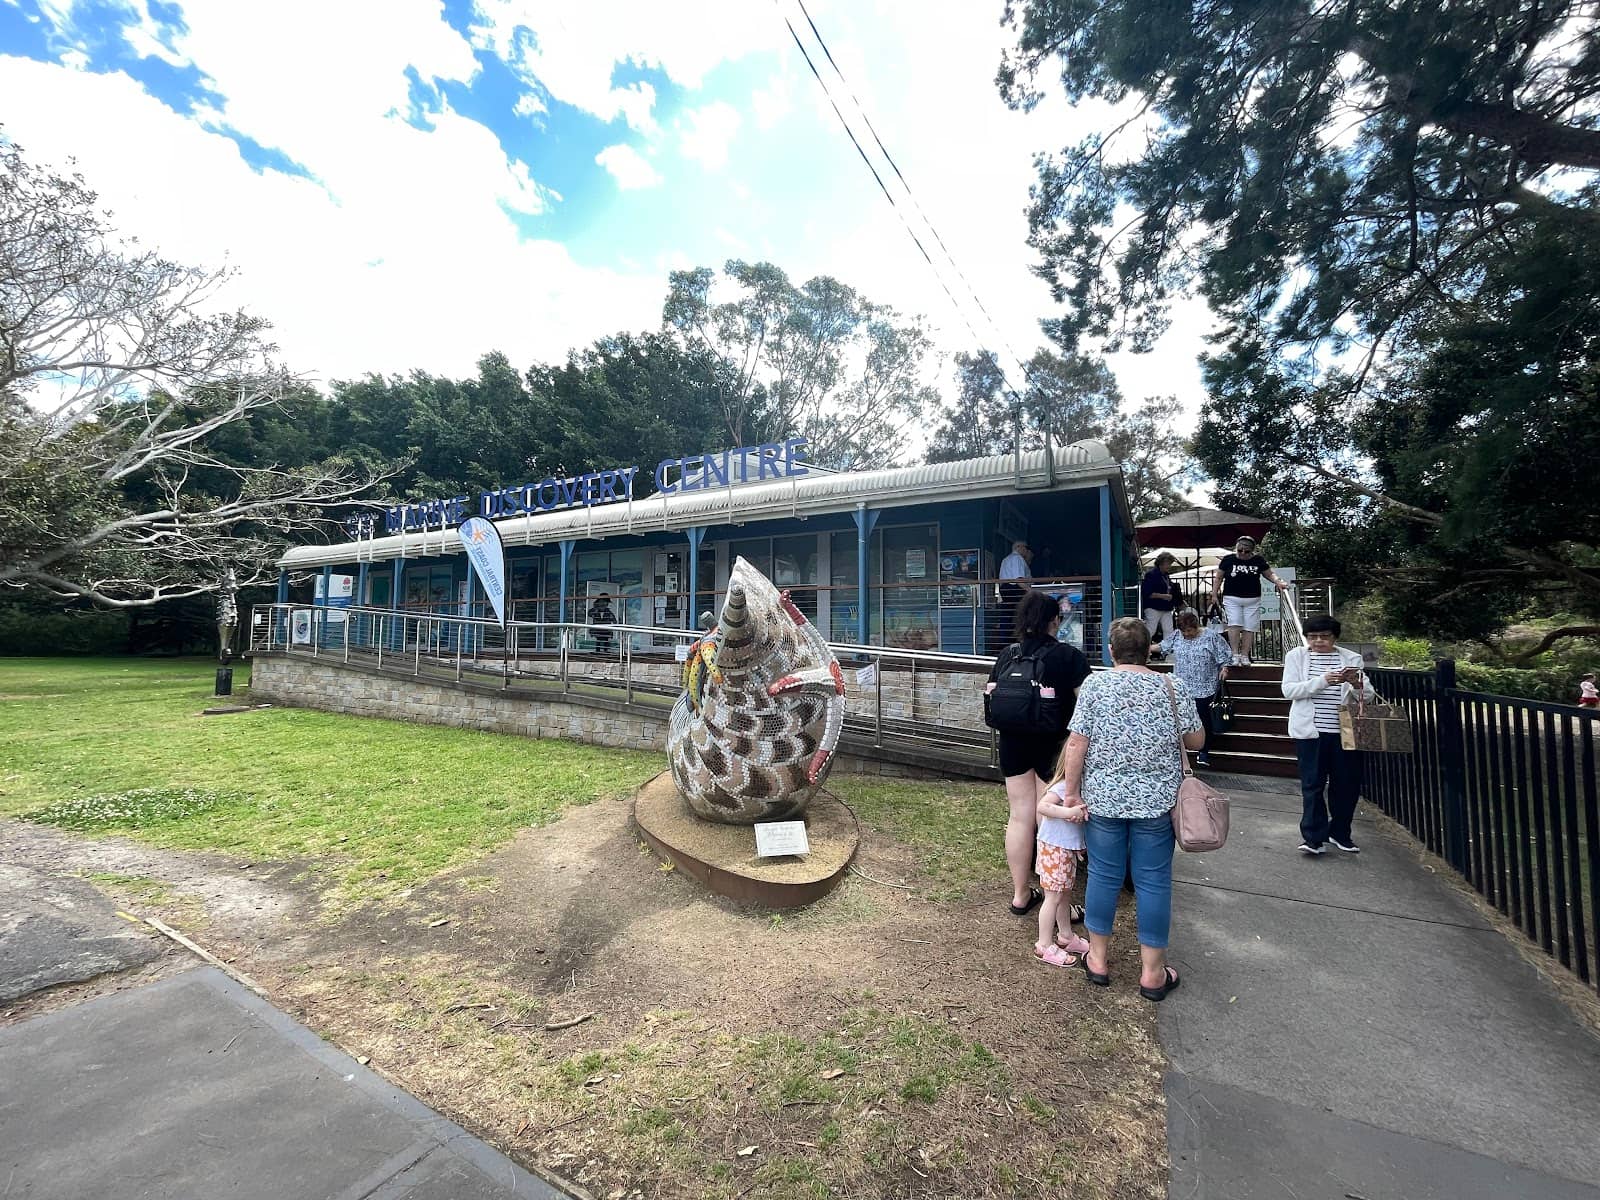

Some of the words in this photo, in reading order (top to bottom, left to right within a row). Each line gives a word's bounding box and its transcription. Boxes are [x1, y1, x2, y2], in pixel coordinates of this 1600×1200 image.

[385, 495, 465, 532] MARINE
[480, 465, 639, 518] DISCOVERY
[655, 437, 809, 493] CENTRE
